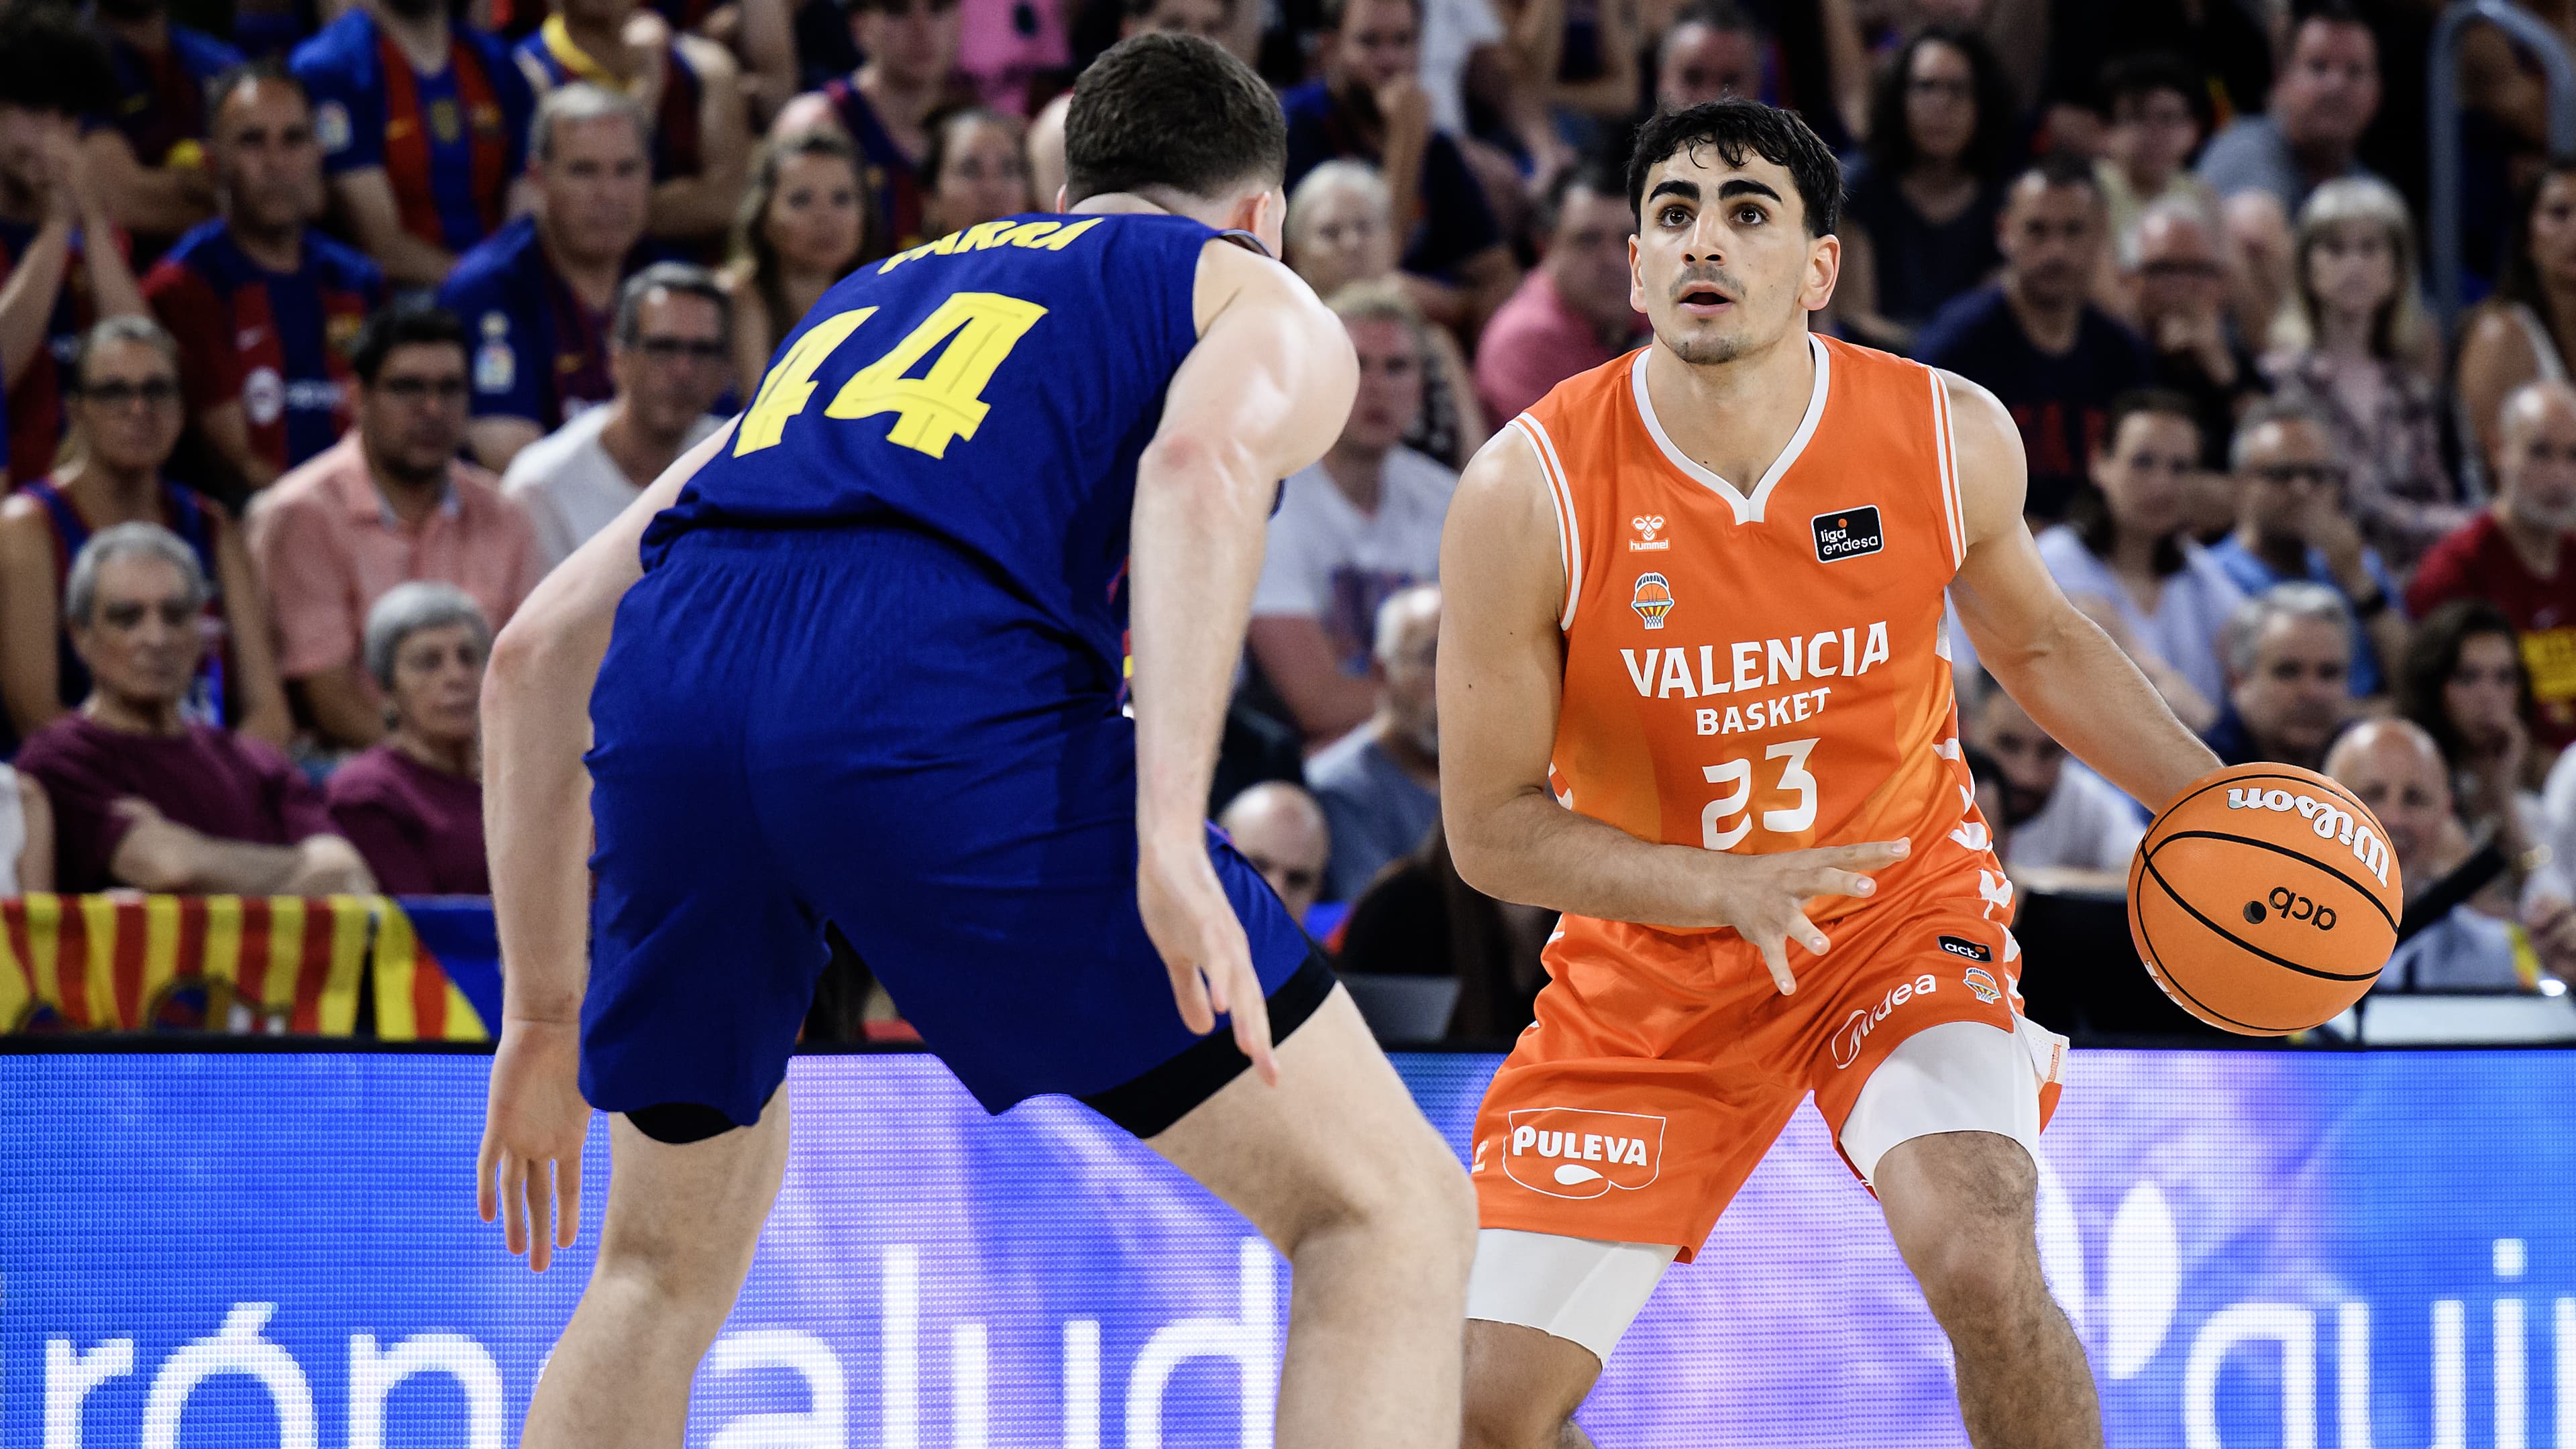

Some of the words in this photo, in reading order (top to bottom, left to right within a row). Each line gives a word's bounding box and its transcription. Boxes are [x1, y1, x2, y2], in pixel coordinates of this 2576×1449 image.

[732, 291, 1049, 460] 44
[1630, 539, 1669, 551] hummel
[1820, 529, 1847, 543] liga
[1823, 535, 1879, 555] endesa
[1620, 621, 1890, 699] VALENCIA
[1695, 686, 1832, 736] BASKET
[1701, 737, 1821, 851] 23
[2226, 787, 2390, 889] Wilson
[2268, 886, 2337, 931] acb
[1945, 942, 1980, 959] acb
[1831, 974, 1937, 1069] Midea
[1512, 1125, 1648, 1167] PULEVA
[2184, 1236, 2576, 1449] qui
